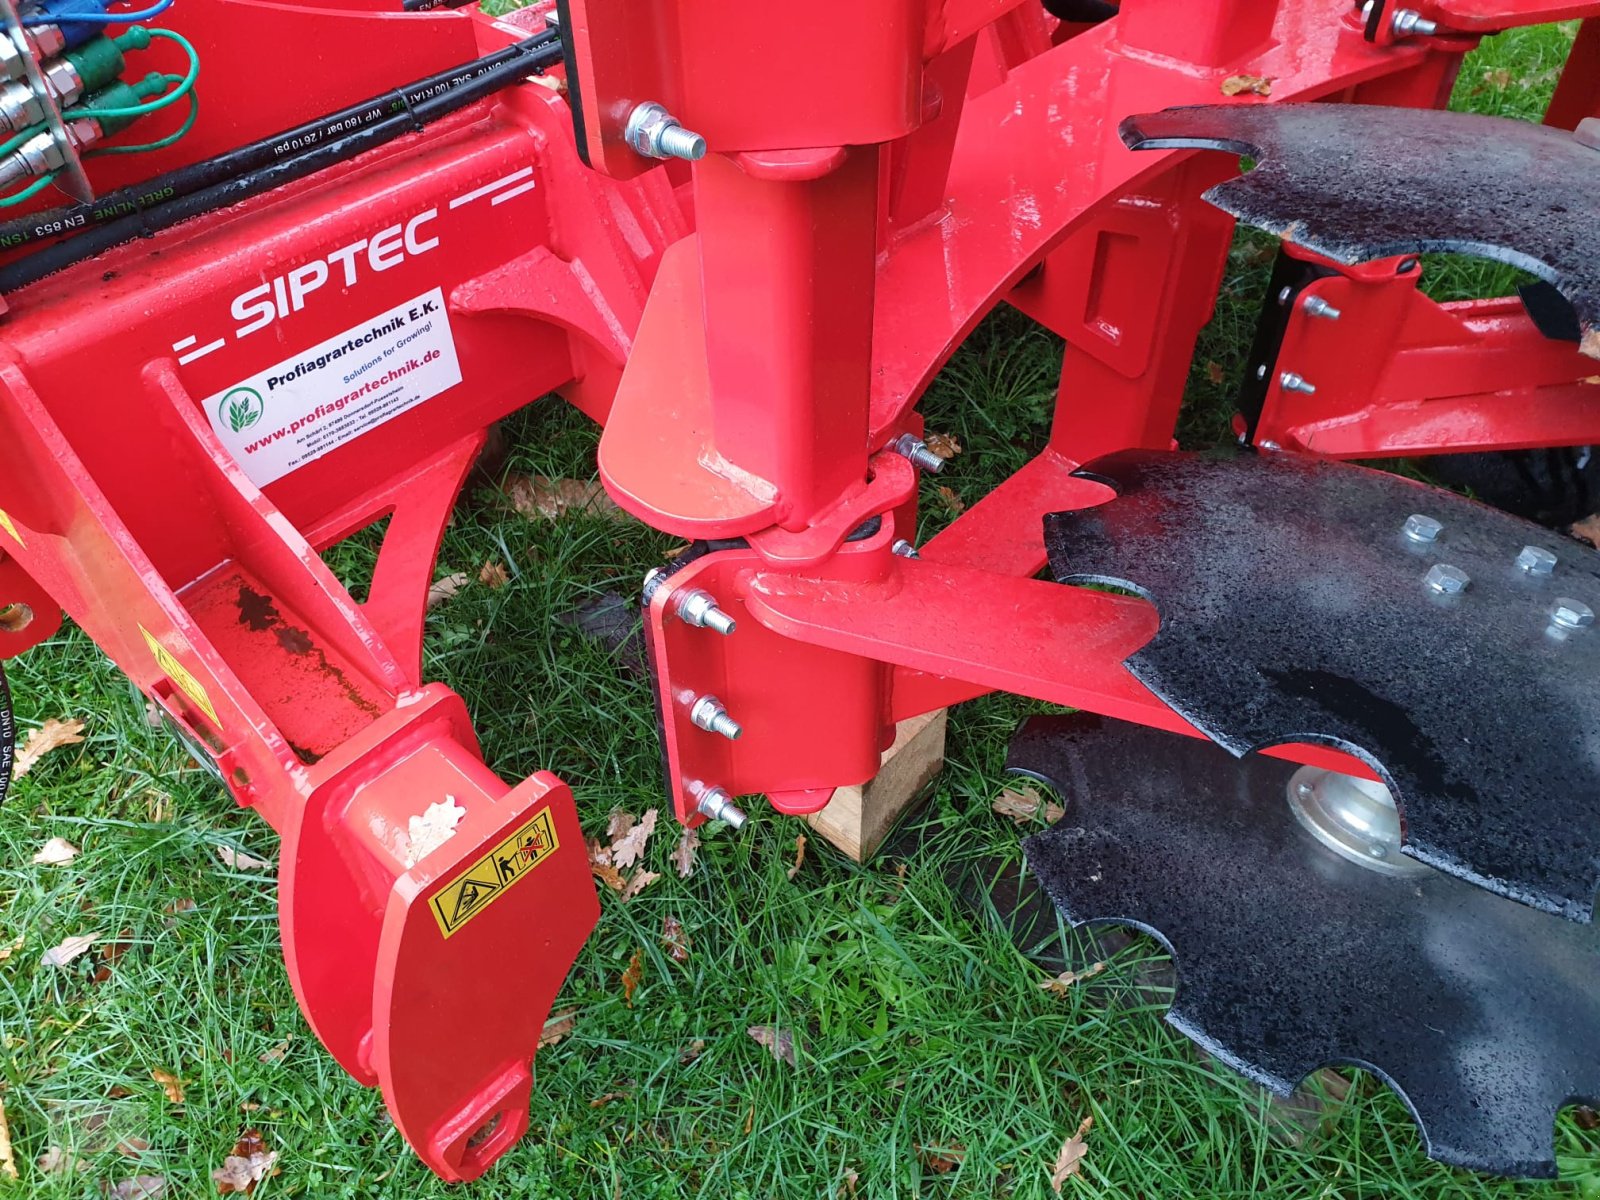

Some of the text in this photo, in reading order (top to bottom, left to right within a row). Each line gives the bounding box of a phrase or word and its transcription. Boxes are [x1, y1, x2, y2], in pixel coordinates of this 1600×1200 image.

[435, 82, 451, 95] 100
[452, 73, 472, 88] SAE
[345, 115, 362, 130] 180
[365, 108, 382, 122] WP
[327, 122, 344, 136] bar
[274, 142, 290, 155] psi
[292, 133, 316, 150] 2610
[35, 221, 62, 237] 853
[64, 214, 85, 230] EN
[230, 208, 439, 339] SIPTEC
[266, 300, 439, 391] Profiagrartechnik E.K.
[343, 321, 433, 384] Solutions for Growing!
[244, 348, 441, 455] www.profiagrartechnik.de
[1, 709, 12, 738] DN10
[3, 745, 12, 768] SAE
